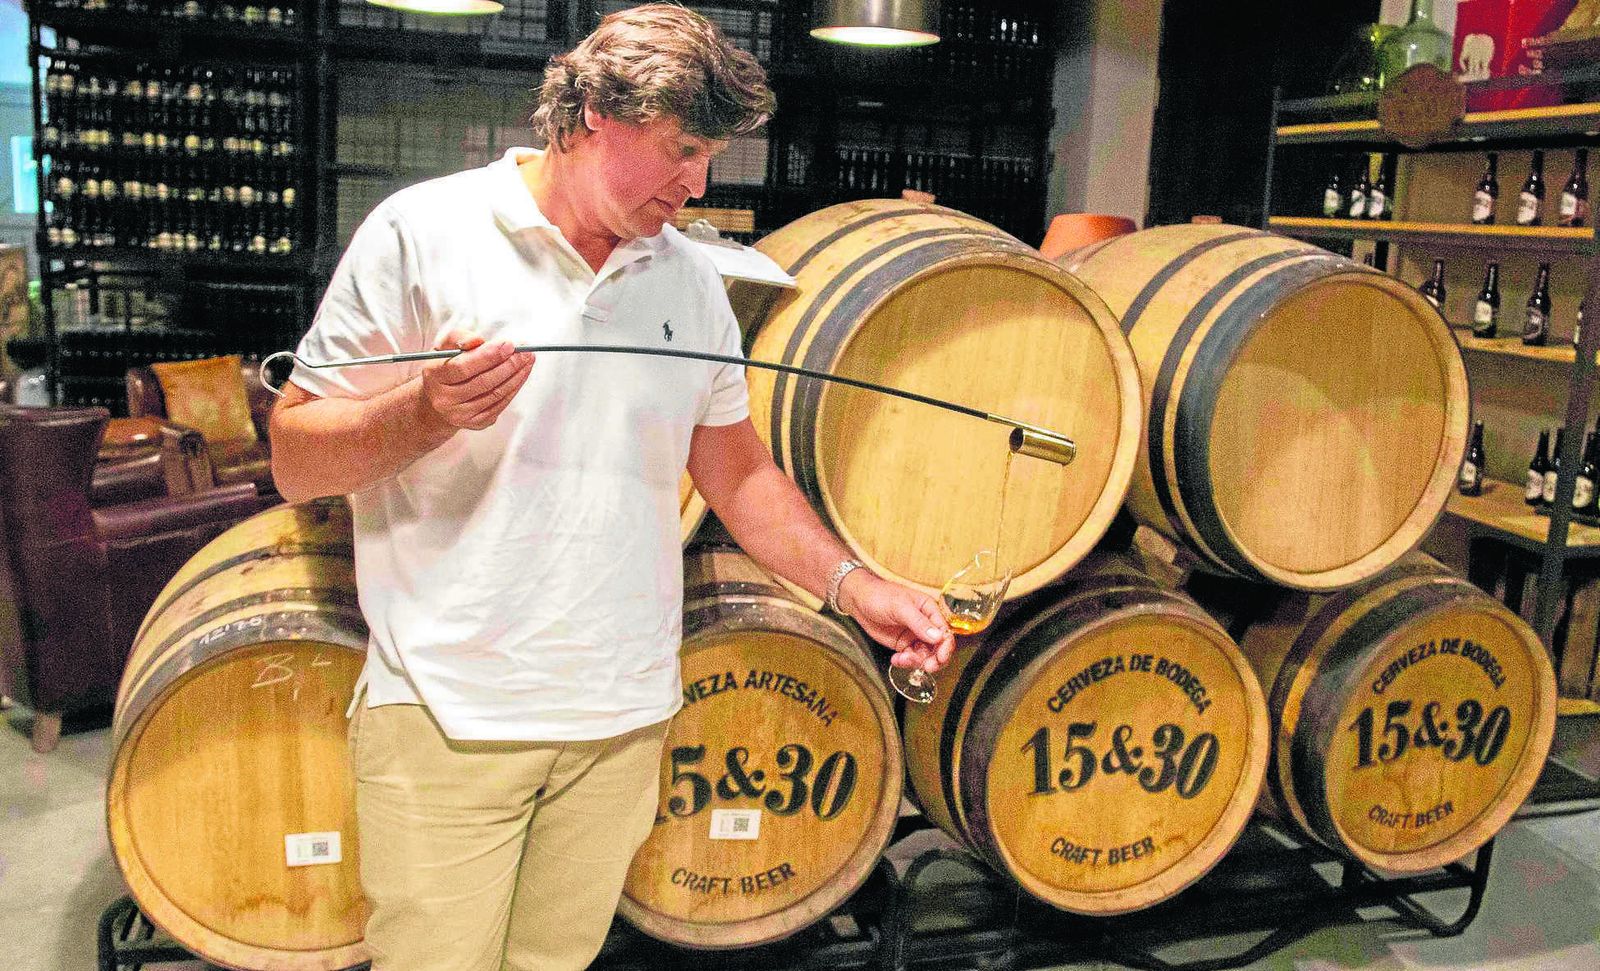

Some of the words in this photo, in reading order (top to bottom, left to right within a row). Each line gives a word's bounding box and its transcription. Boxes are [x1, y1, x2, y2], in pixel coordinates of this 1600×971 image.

[1047, 656, 1125, 713] CERVEZA
[1129, 654, 1153, 672] DE
[1155, 657, 1211, 715] BODEGA
[1373, 640, 1436, 694] CERVEZA
[1440, 638, 1460, 654] DE
[682, 672, 738, 707] VEZA
[744, 669, 839, 727] ARTESANA
[1020, 720, 1220, 799] 15&30
[1348, 699, 1511, 771] 15&30
[655, 743, 858, 825] 5&30
[1368, 804, 1410, 829] CRAFT
[1415, 800, 1454, 828] BEER
[671, 868, 732, 895] CRAFT
[741, 862, 796, 893] BEER
[1051, 837, 1103, 865] CRAFT
[1107, 836, 1155, 865] BEER
